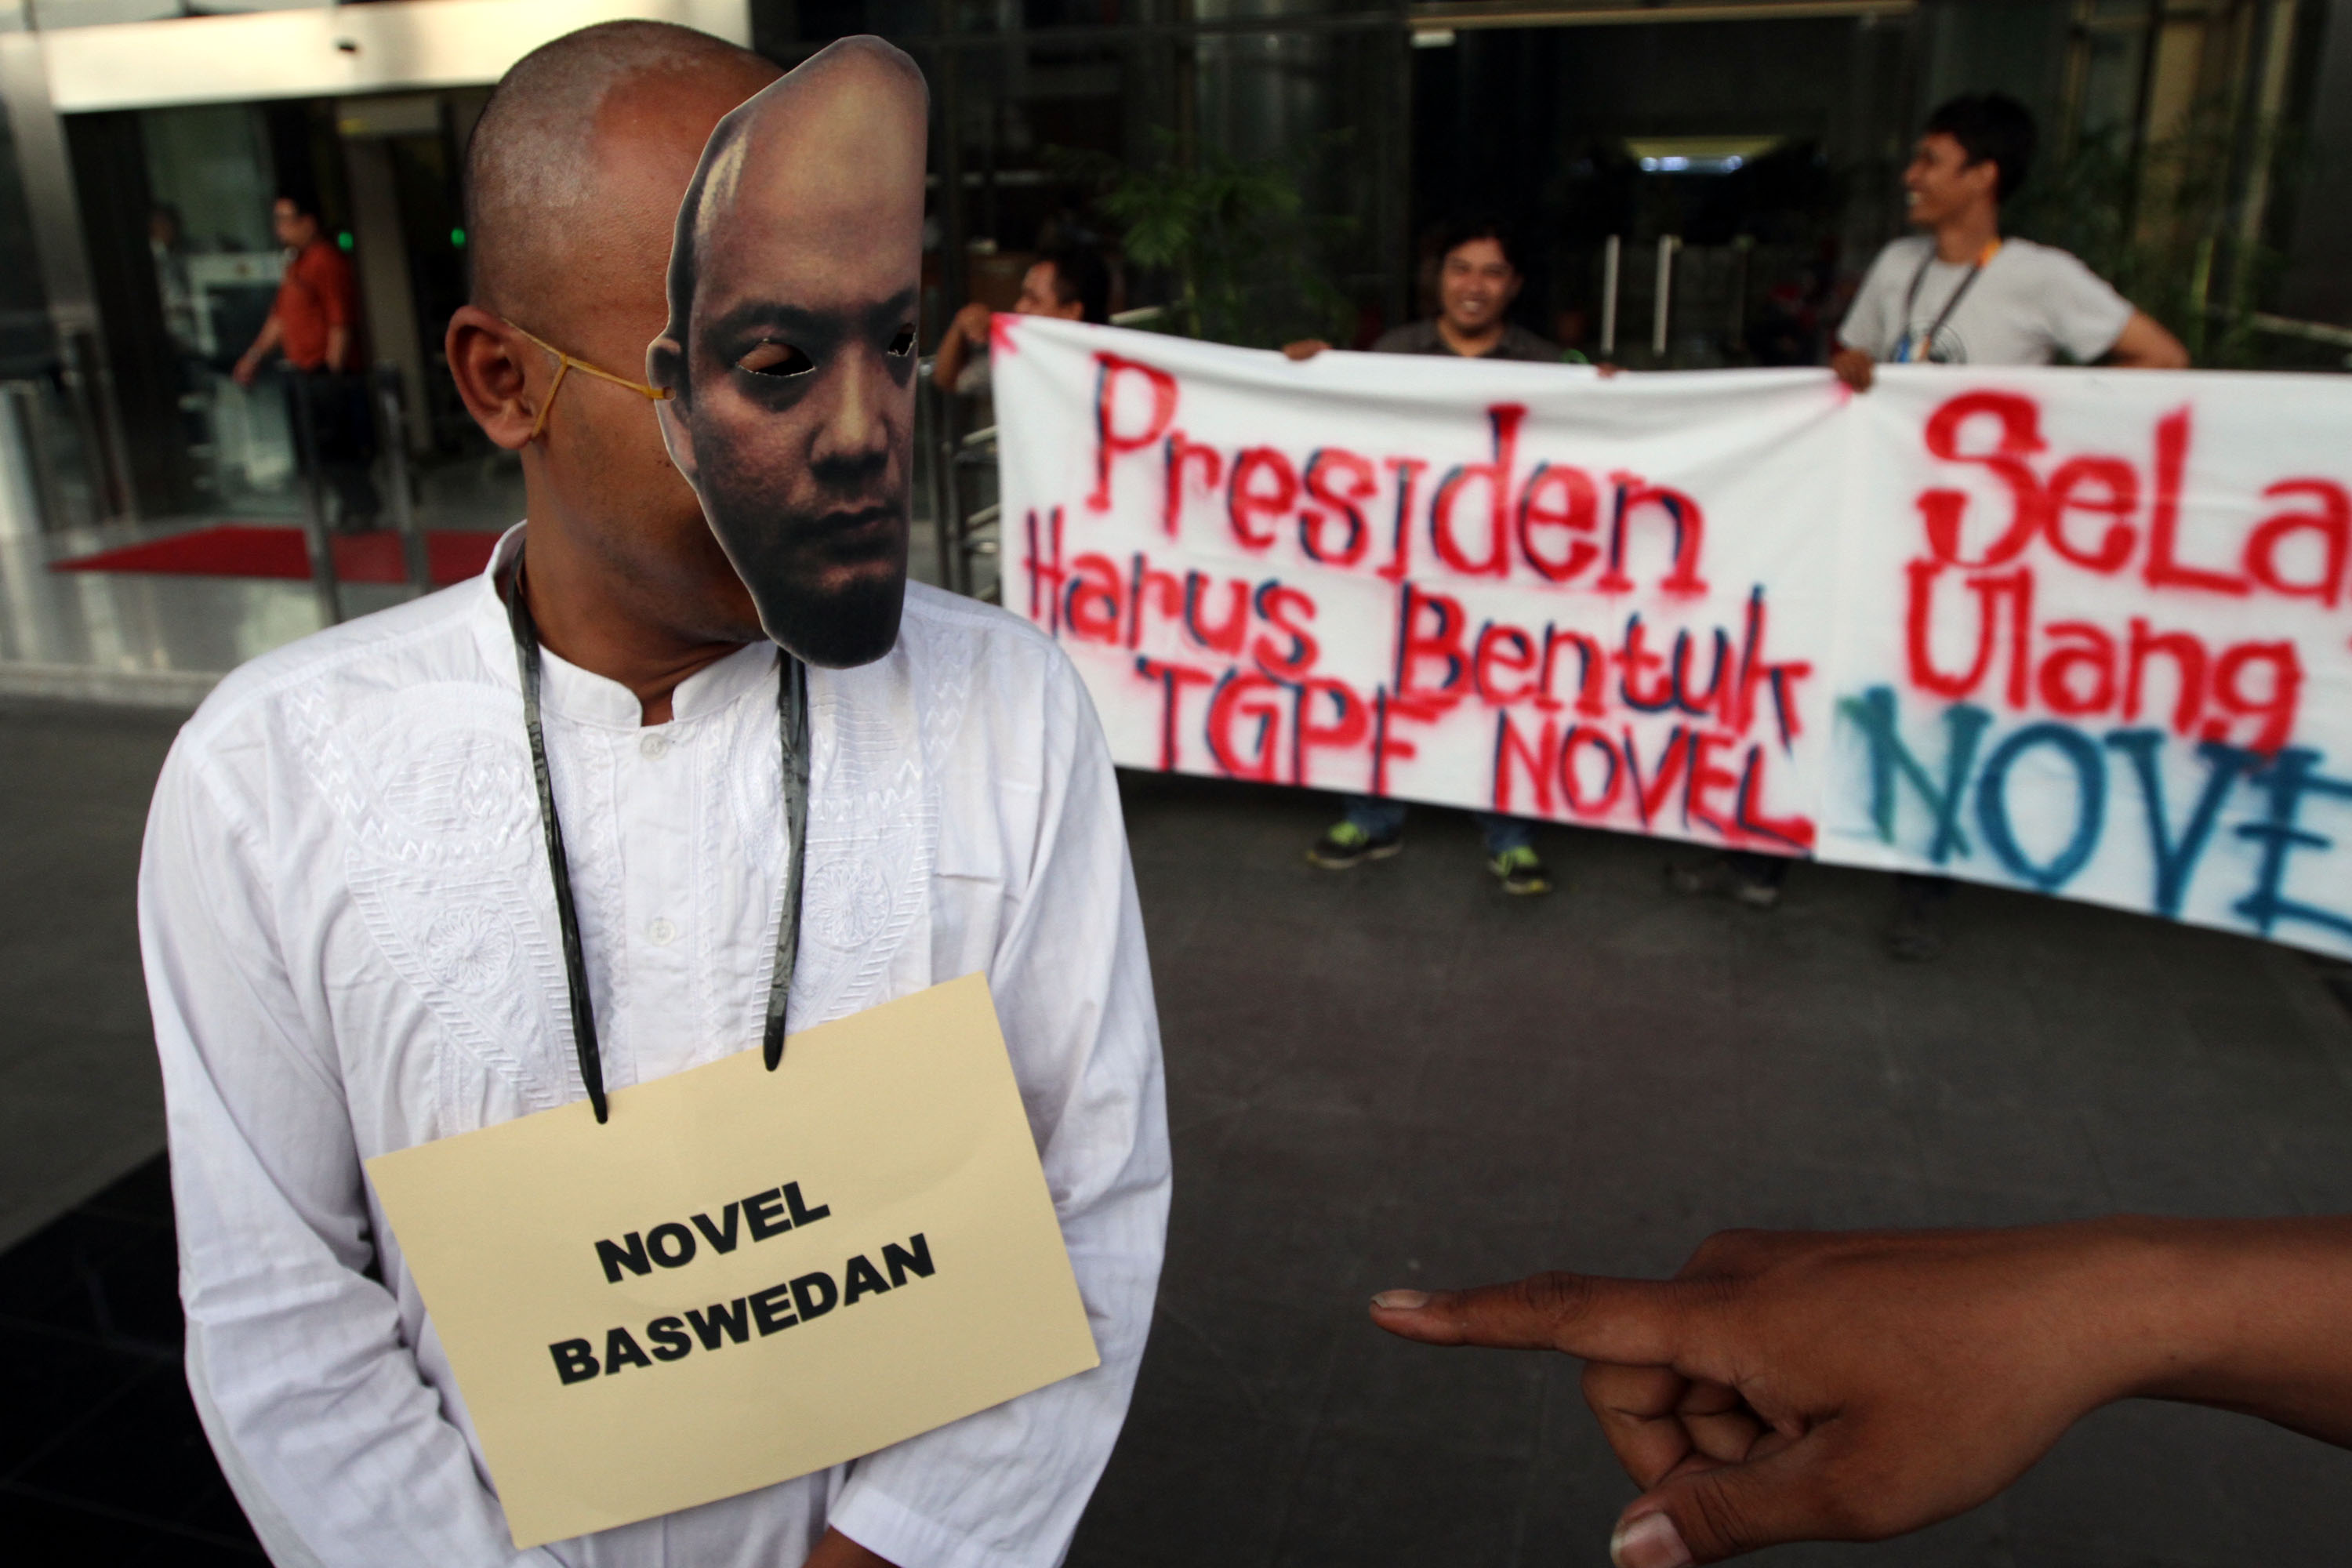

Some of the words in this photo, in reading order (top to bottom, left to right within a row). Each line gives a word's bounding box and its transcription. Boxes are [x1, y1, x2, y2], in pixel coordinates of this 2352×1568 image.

[1023, 506, 1319, 685] Harus
[1393, 583, 1813, 757] Bentuk
[1905, 558, 2303, 765] Ulang
[1134, 655, 1439, 795] TGPF
[1493, 709, 1816, 858] NOVEL
[1835, 687, 2352, 938] NOVE
[549, 1232, 935, 1385] BASWEDAN
[594, 1181, 831, 1284] NOVEL
